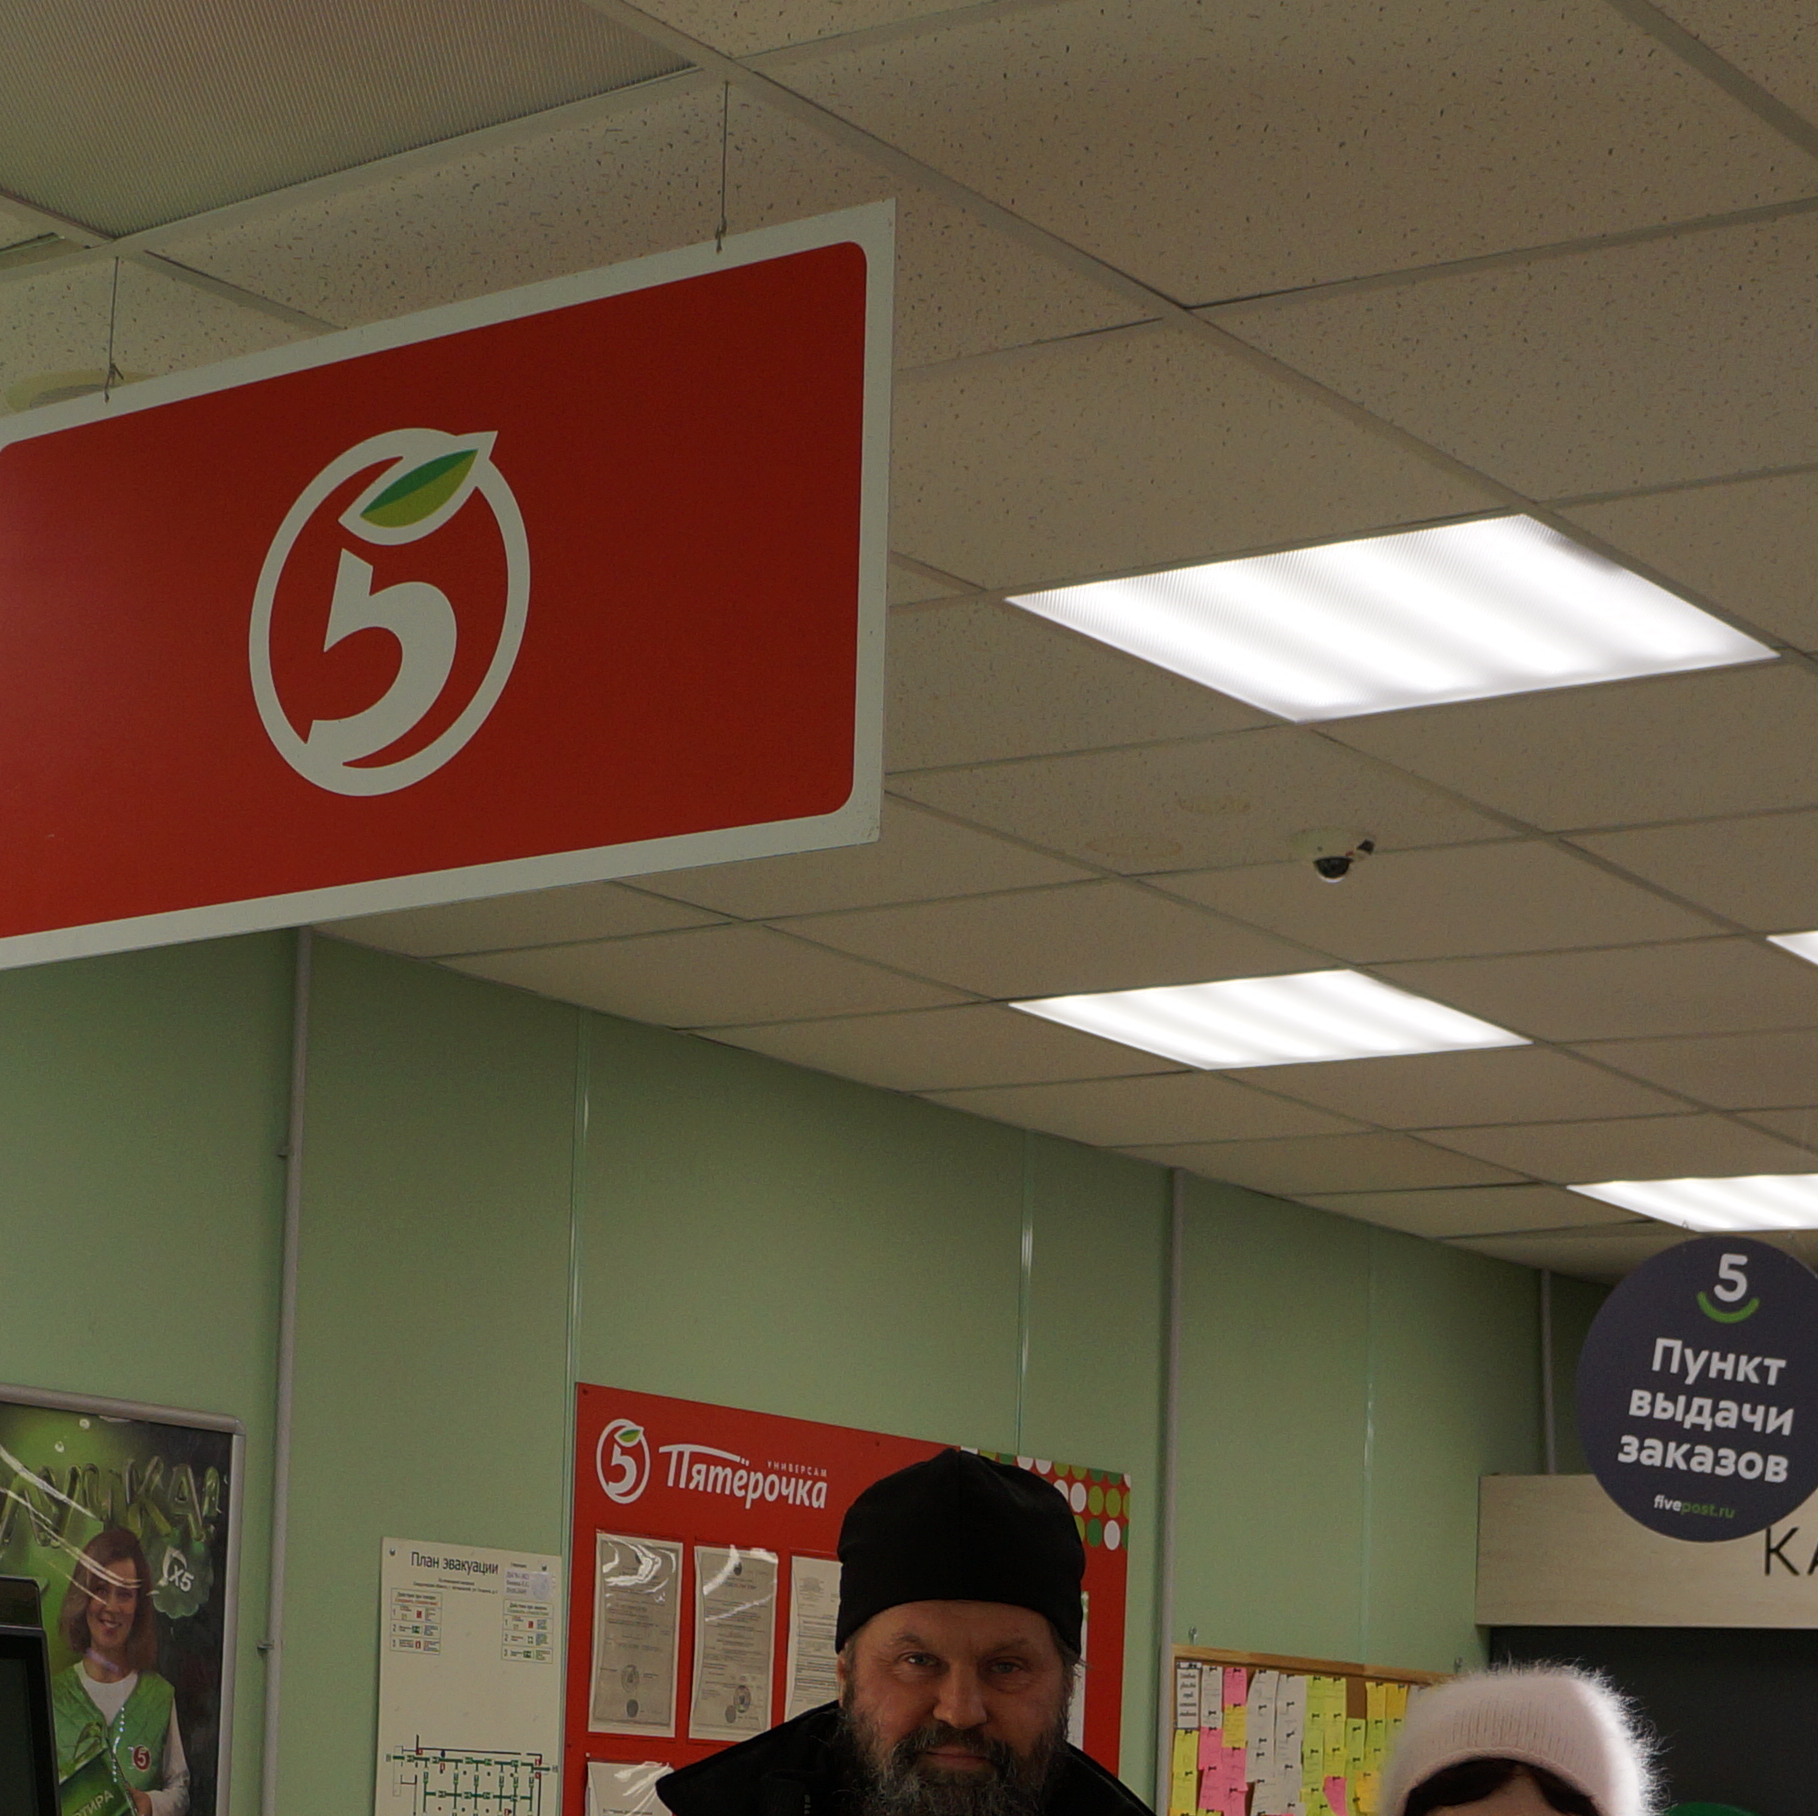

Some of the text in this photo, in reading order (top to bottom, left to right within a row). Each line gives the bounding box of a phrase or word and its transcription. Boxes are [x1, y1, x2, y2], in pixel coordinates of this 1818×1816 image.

[1713, 1254, 1749, 1301] 5
[1651, 1337, 1786, 1387] Пункт
[1629, 1388, 1795, 1438] выдачи
[767, 1460, 827, 1477] УНИВЕРСАМ
[1617, 1434, 1789, 1484] заказов
[1653, 1494, 1735, 1519] fivepost.ru
[411, 1552, 499, 1575] План эвакуации
